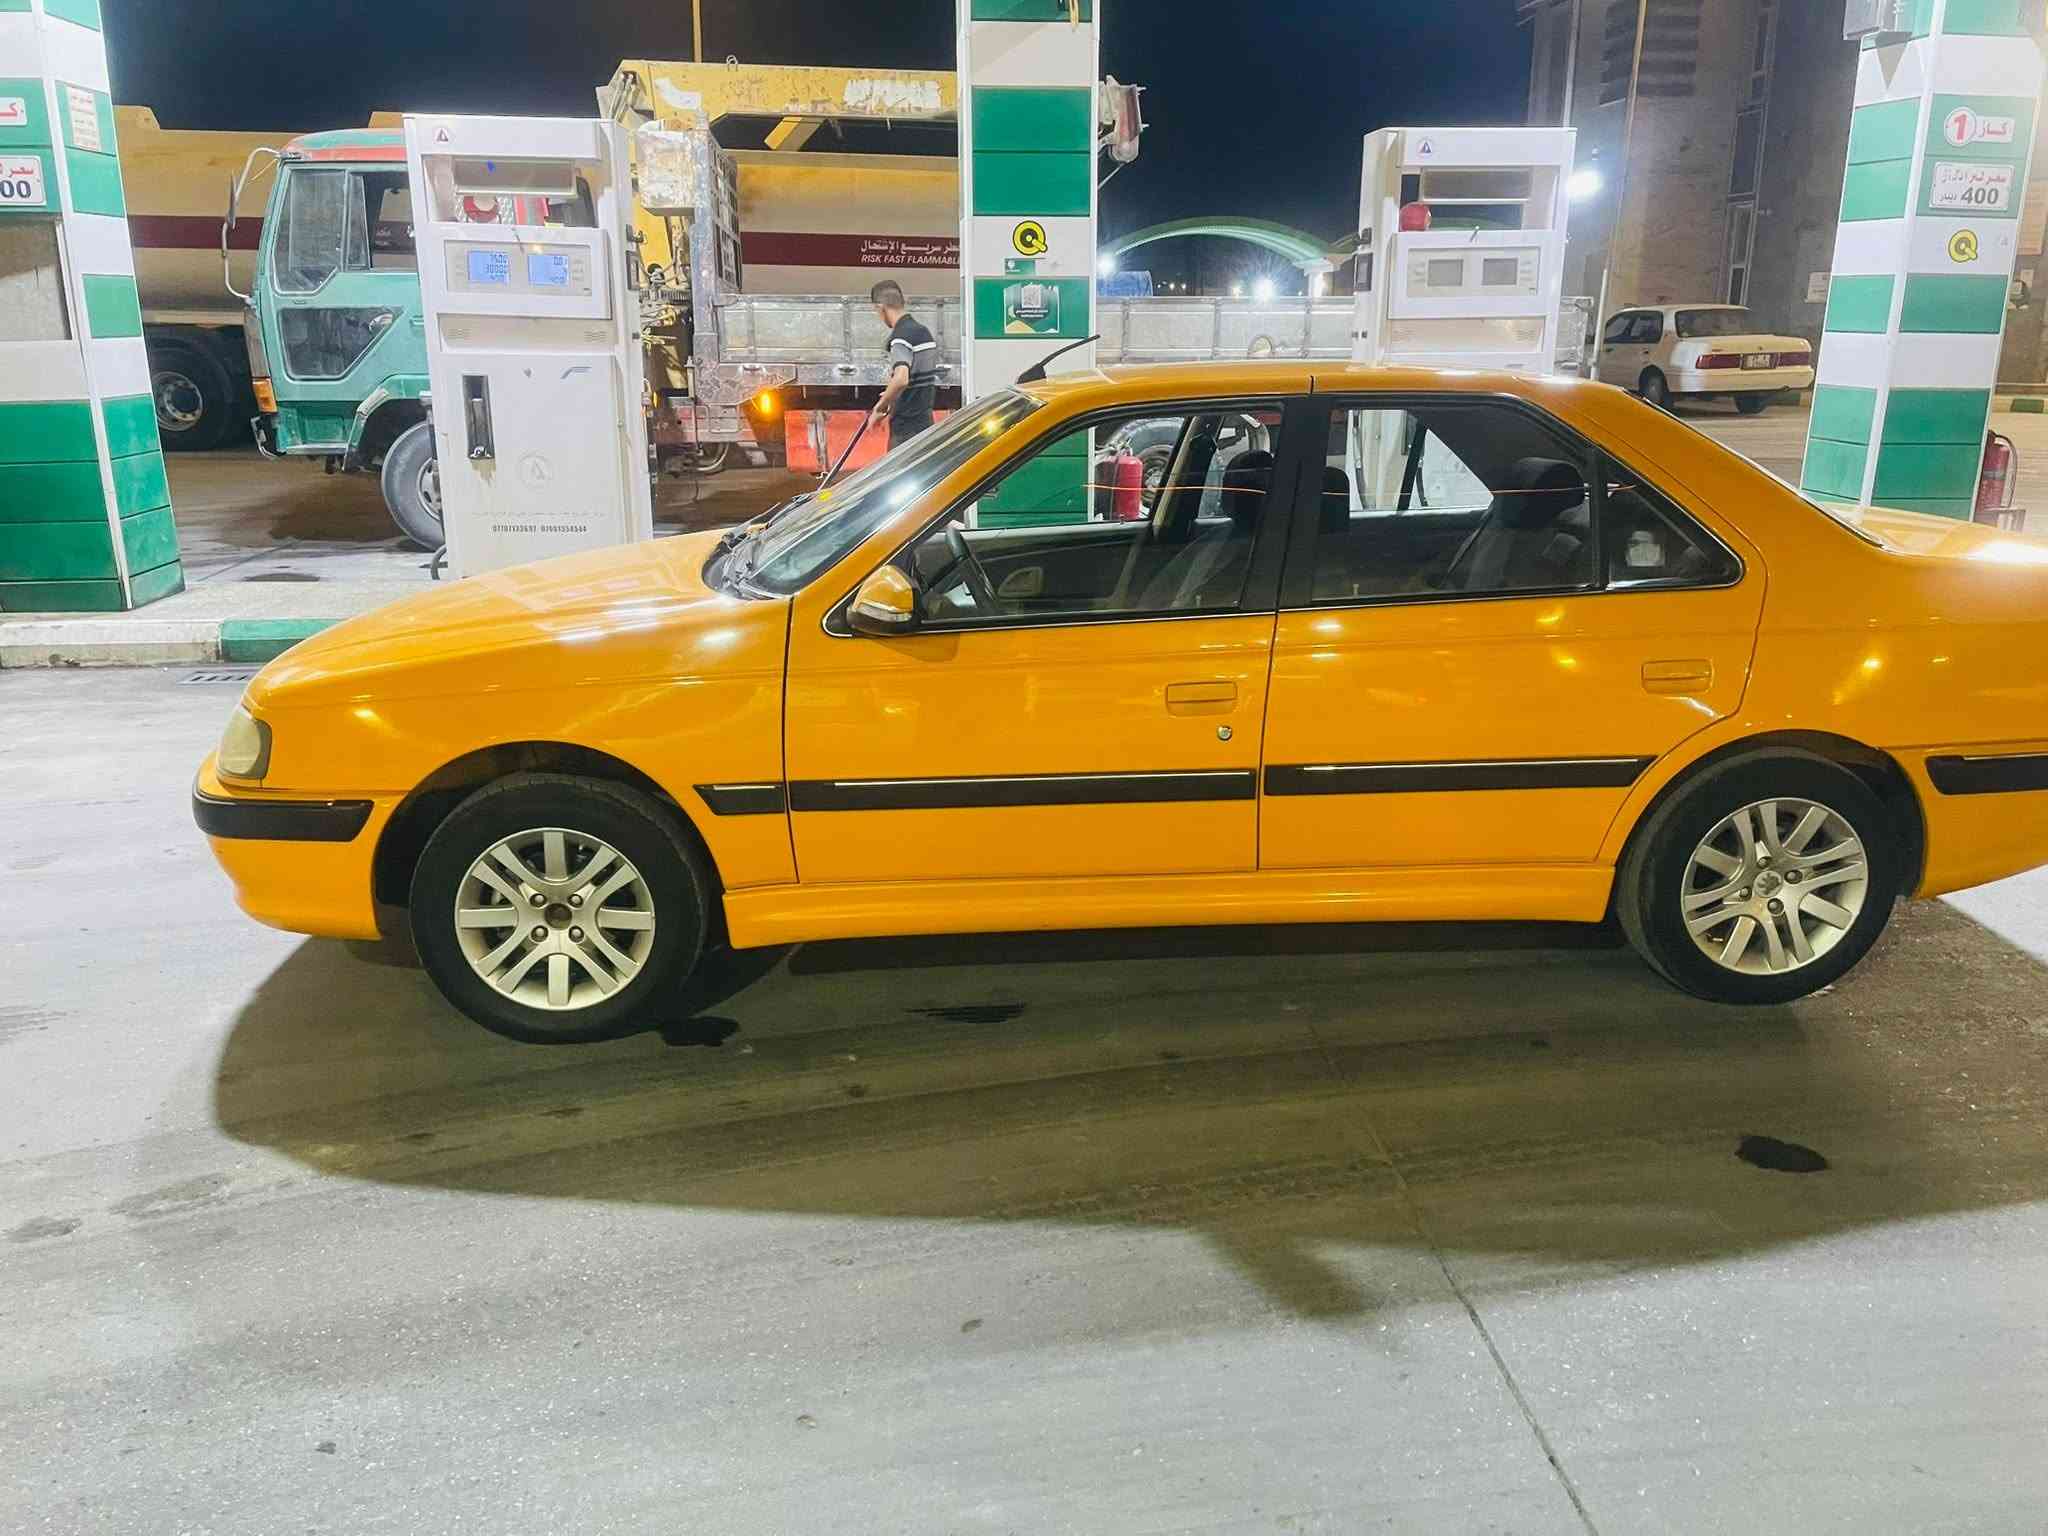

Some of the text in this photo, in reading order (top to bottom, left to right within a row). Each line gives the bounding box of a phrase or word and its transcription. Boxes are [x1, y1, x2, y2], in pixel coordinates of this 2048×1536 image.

[1961, 187, 1999, 205] 400
[861, 253, 882, 264] RISK
[883, 254, 905, 265] FAST
